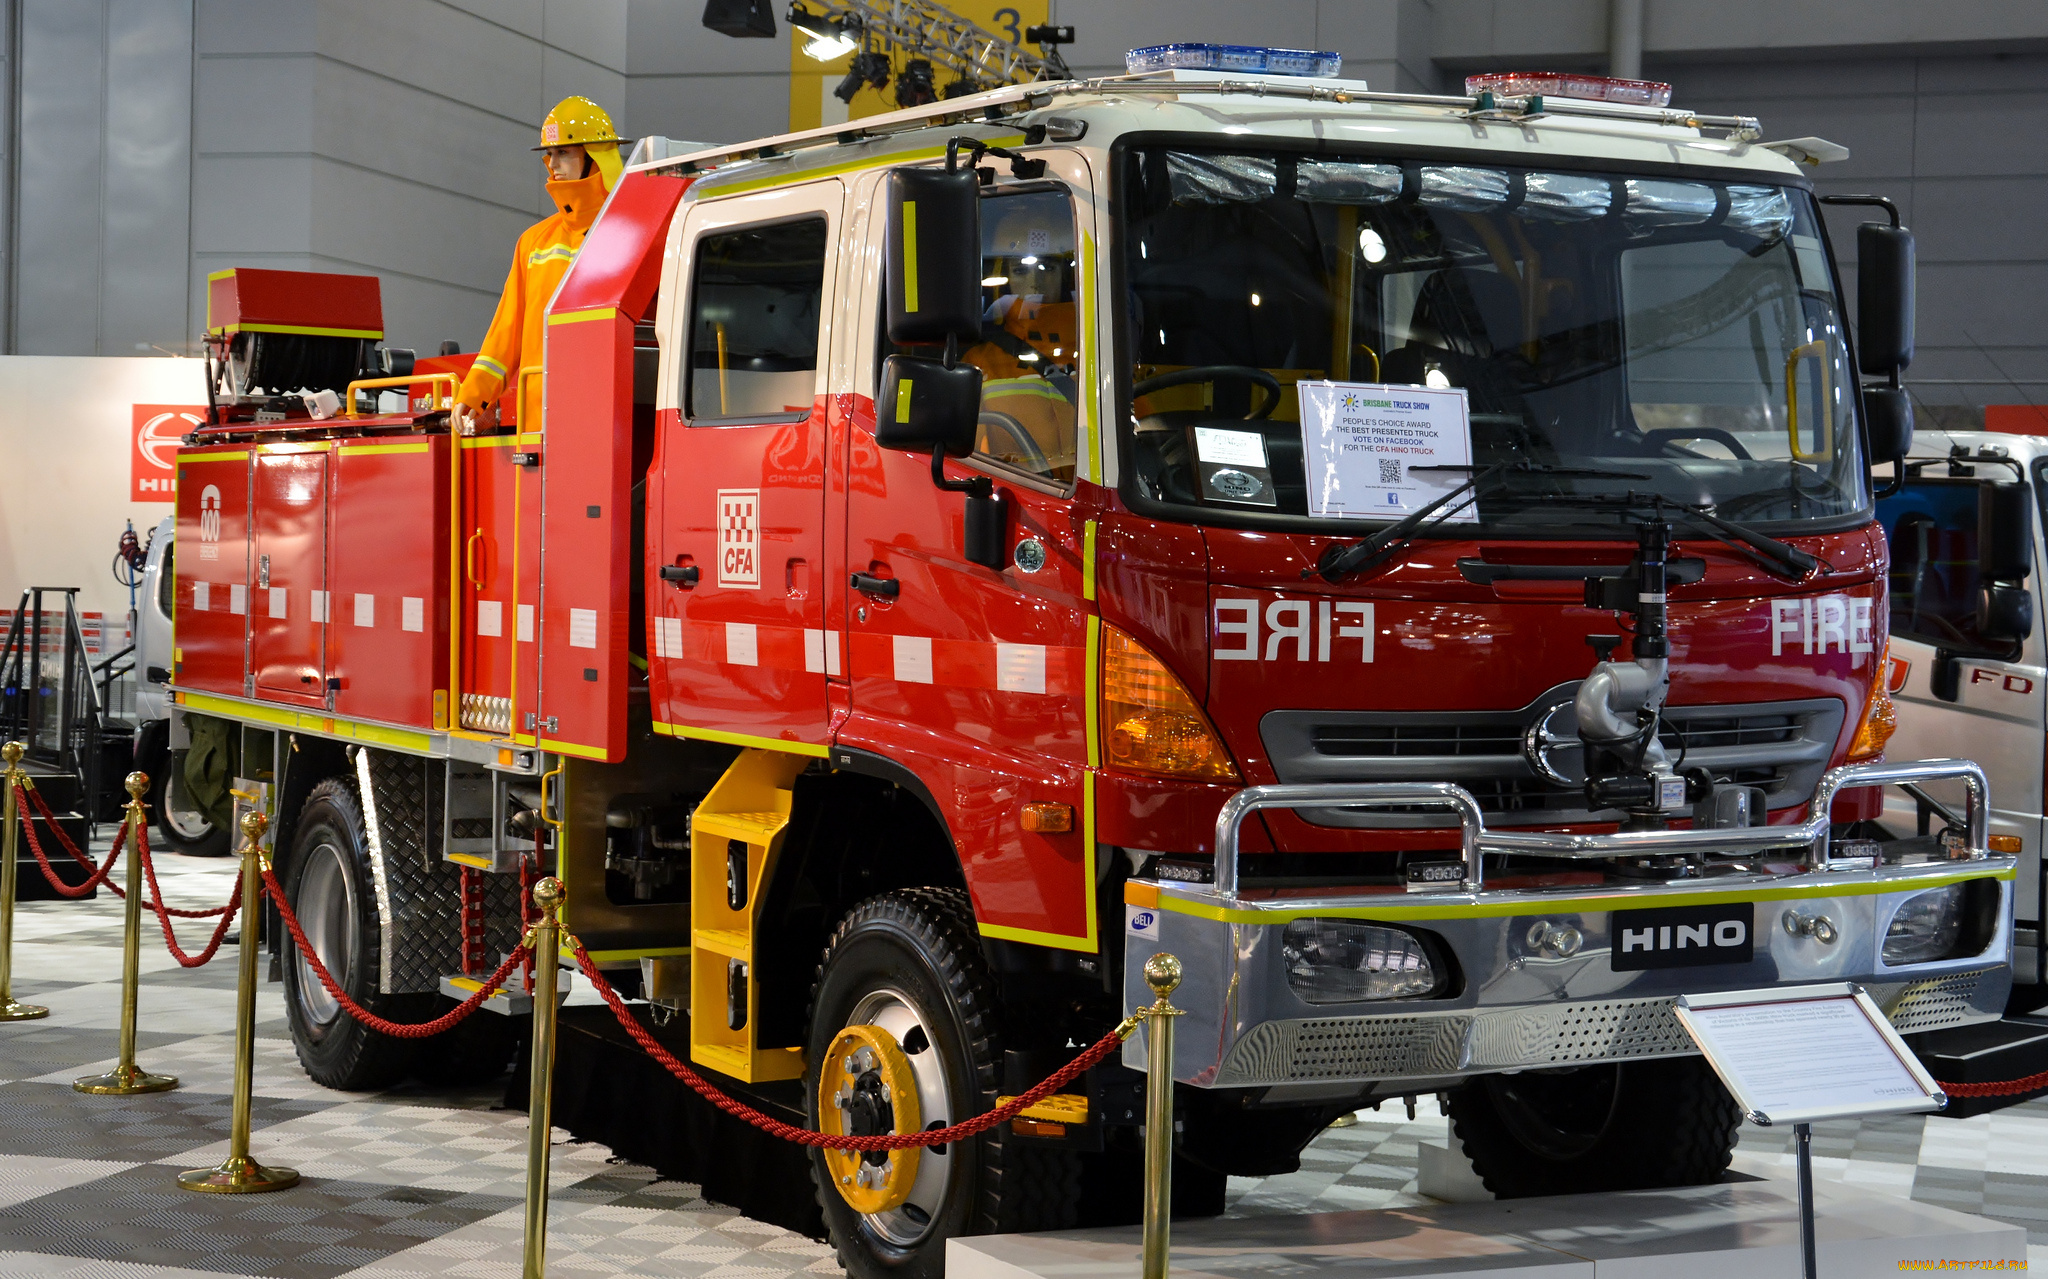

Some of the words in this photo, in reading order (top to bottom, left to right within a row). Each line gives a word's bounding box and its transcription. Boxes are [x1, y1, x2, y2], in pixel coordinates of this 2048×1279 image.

[993, 8, 1021, 46] 3
[1363, 399, 1392, 408] BRISBANE
[1393, 400, 1412, 409] TRUCK
[1413, 402, 1430, 410] SHOW
[1343, 418, 1377, 426] PEOPLE'S
[1378, 419, 1405, 427] CHOICE
[1371, 428, 1413, 437] PRESENTED
[1415, 430, 1439, 438] TRUCK
[1386, 438, 1424, 446] FACEBOOK
[1391, 446, 1409, 454] HINO
[1410, 447, 1434, 455] TRUCK
[725, 548, 753, 574] CFA
[1771, 597, 1874, 656] FIRE
[1622, 919, 1747, 953] HINO
